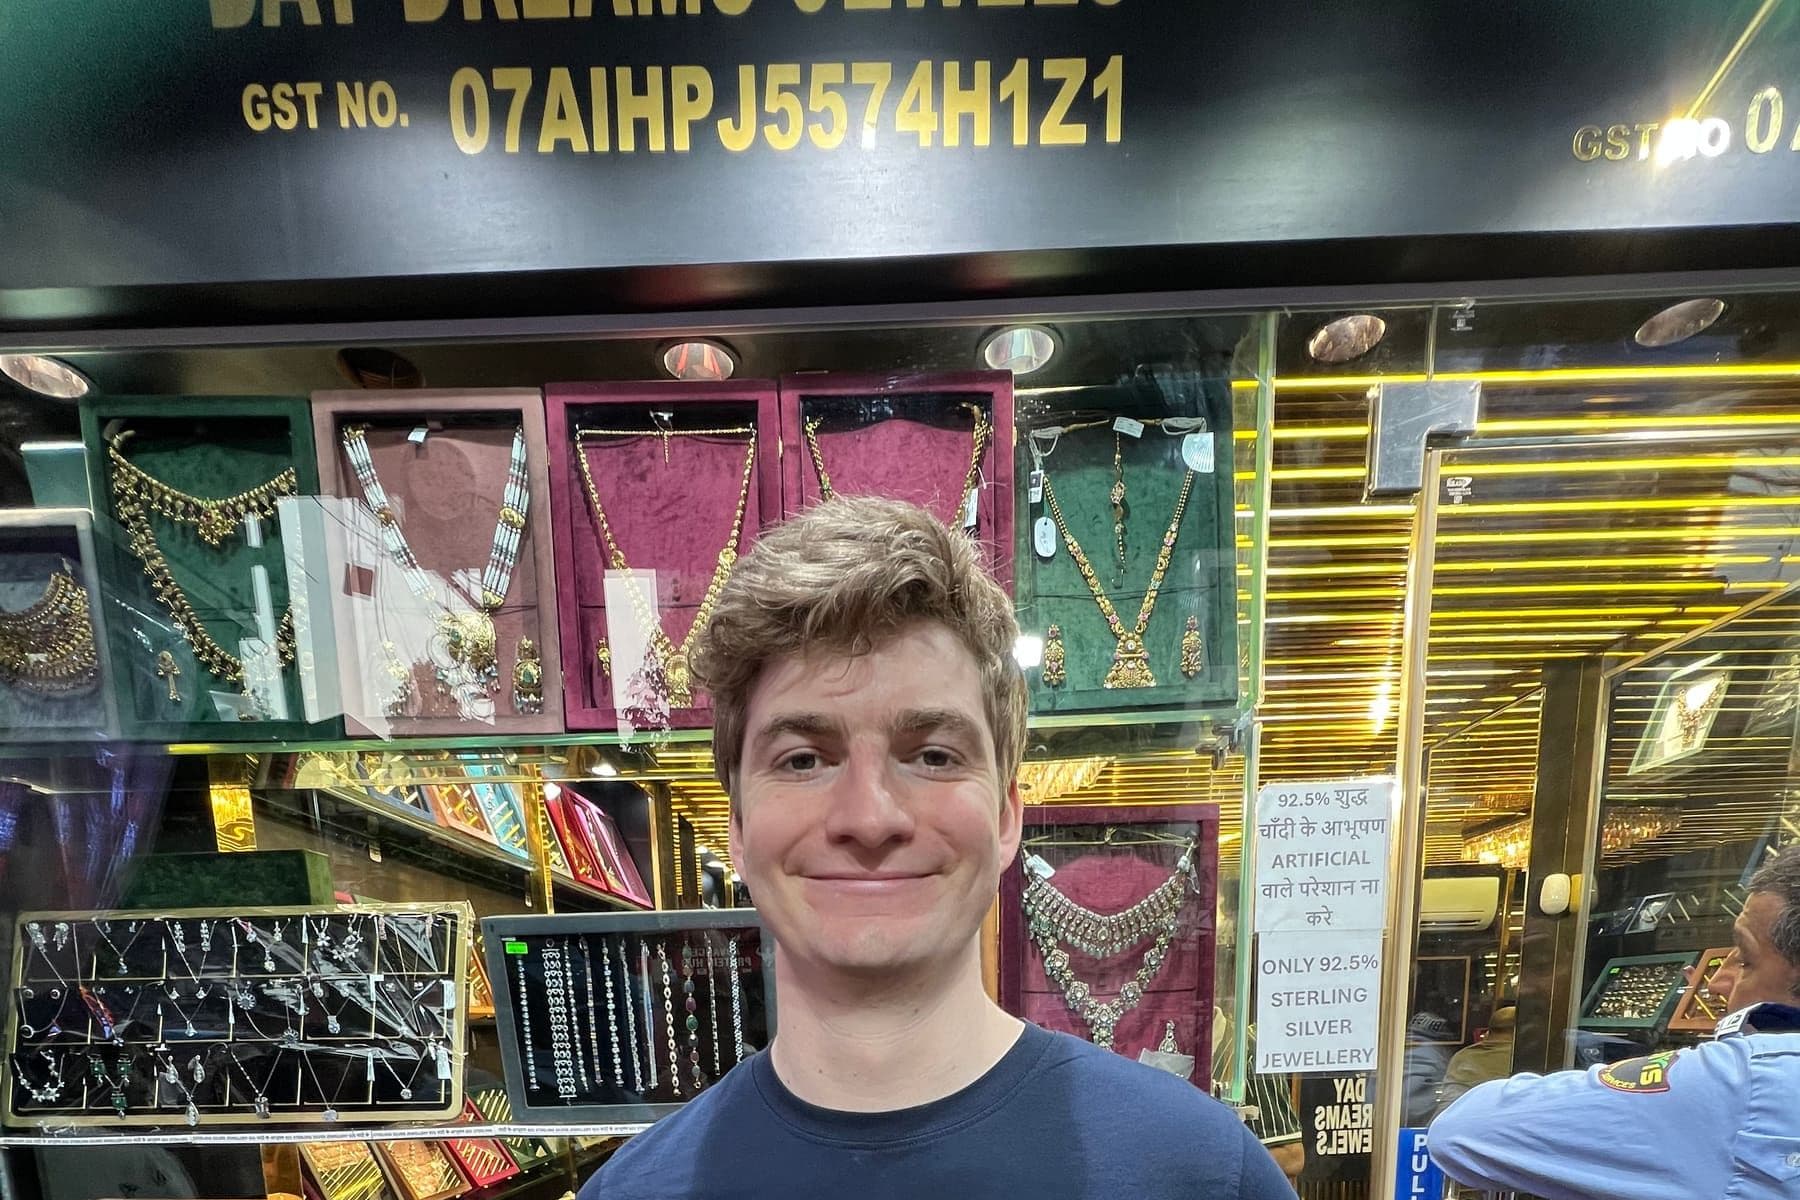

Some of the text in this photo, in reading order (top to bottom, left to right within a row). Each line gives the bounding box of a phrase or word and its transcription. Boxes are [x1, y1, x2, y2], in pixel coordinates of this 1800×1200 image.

[241, 54, 1123, 155] GST NO. 07AIHPJ5574H1Z1
[1572, 122, 1659, 162] GST
[1278, 788, 1369, 809] 92.5% शुद्ध
[1258, 816, 1387, 840] चाँदी के आभूषण
[1271, 850, 1371, 869] ARTIFICIAL
[1261, 876, 1380, 899] वाले परेशान ना
[1305, 905, 1333, 926] करे
[1262, 954, 1378, 975] ONLY 92.5%
[1271, 987, 1368, 1008] STERLING
[1285, 1019, 1352, 1037] SILVER
[1262, 1048, 1374, 1069] JEWELLERY
